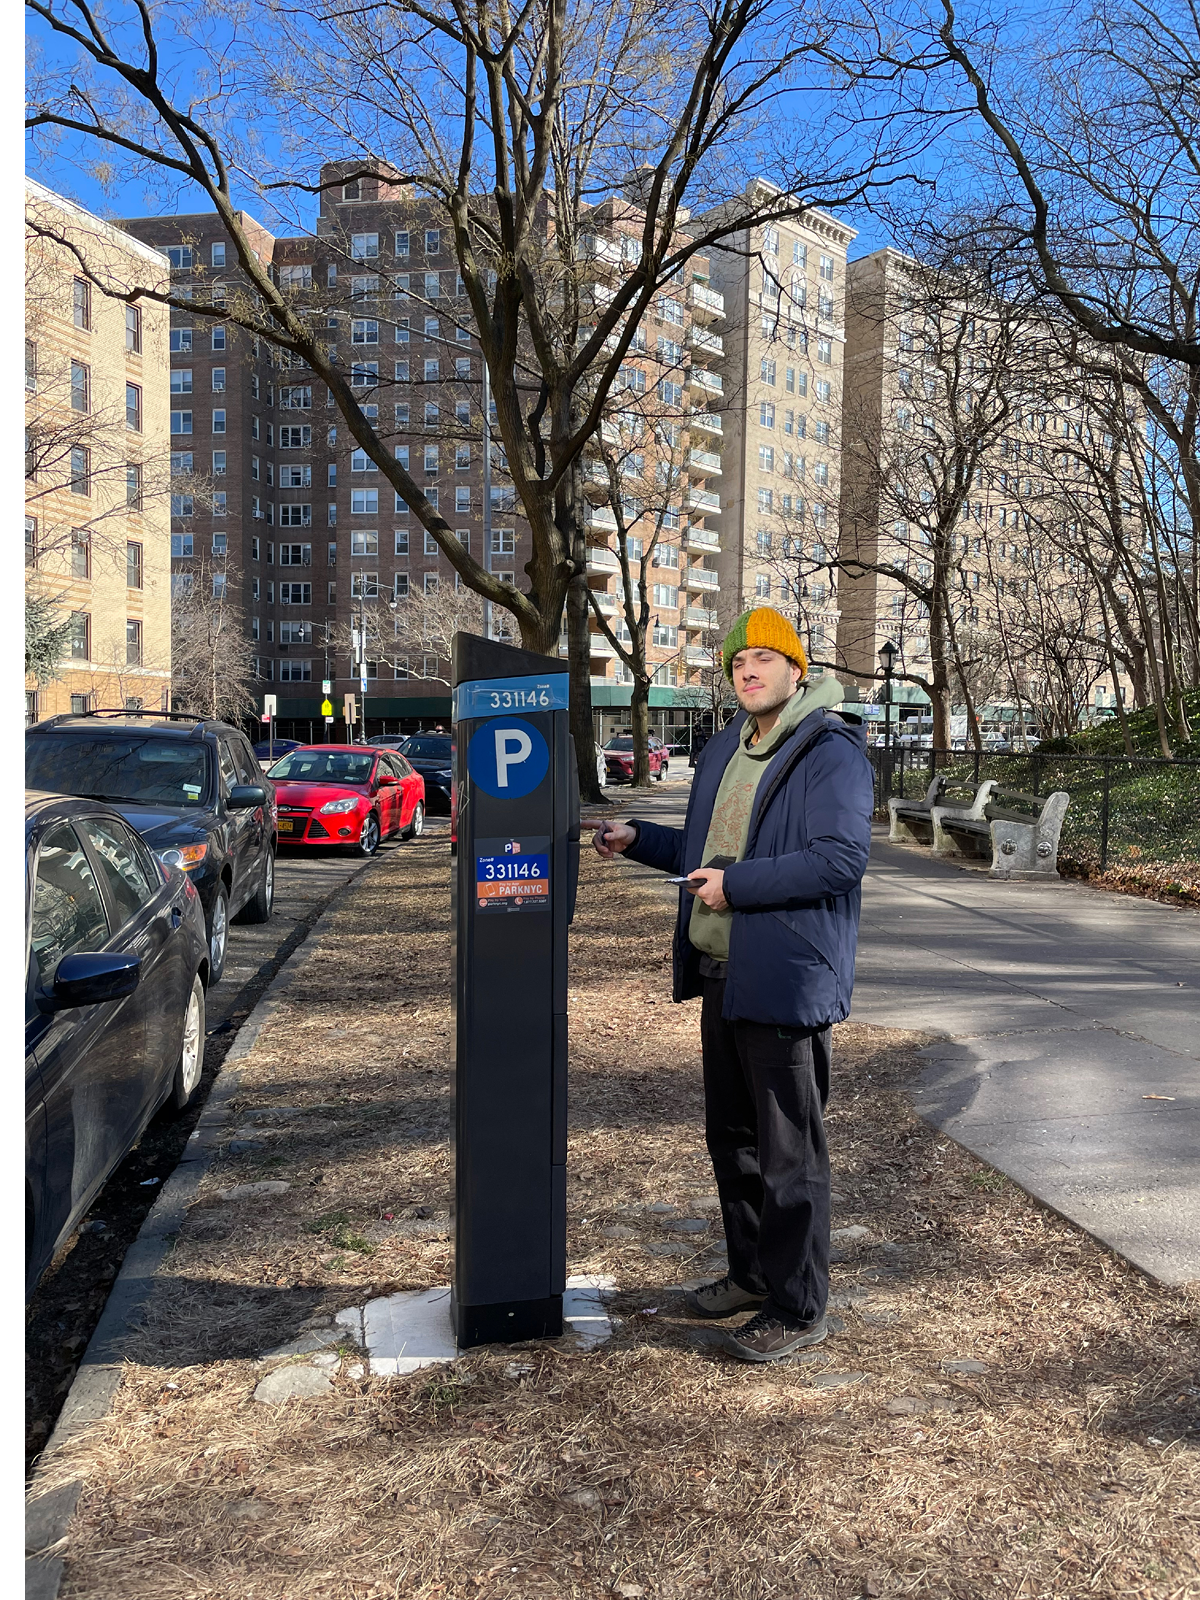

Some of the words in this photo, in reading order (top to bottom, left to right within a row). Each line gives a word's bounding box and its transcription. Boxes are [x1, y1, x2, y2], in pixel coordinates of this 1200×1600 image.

[490, 690, 549, 708] 331146
[494, 728, 533, 788] P
[486, 862, 540, 879] 331146
[500, 884, 542, 895] PARKNYC
